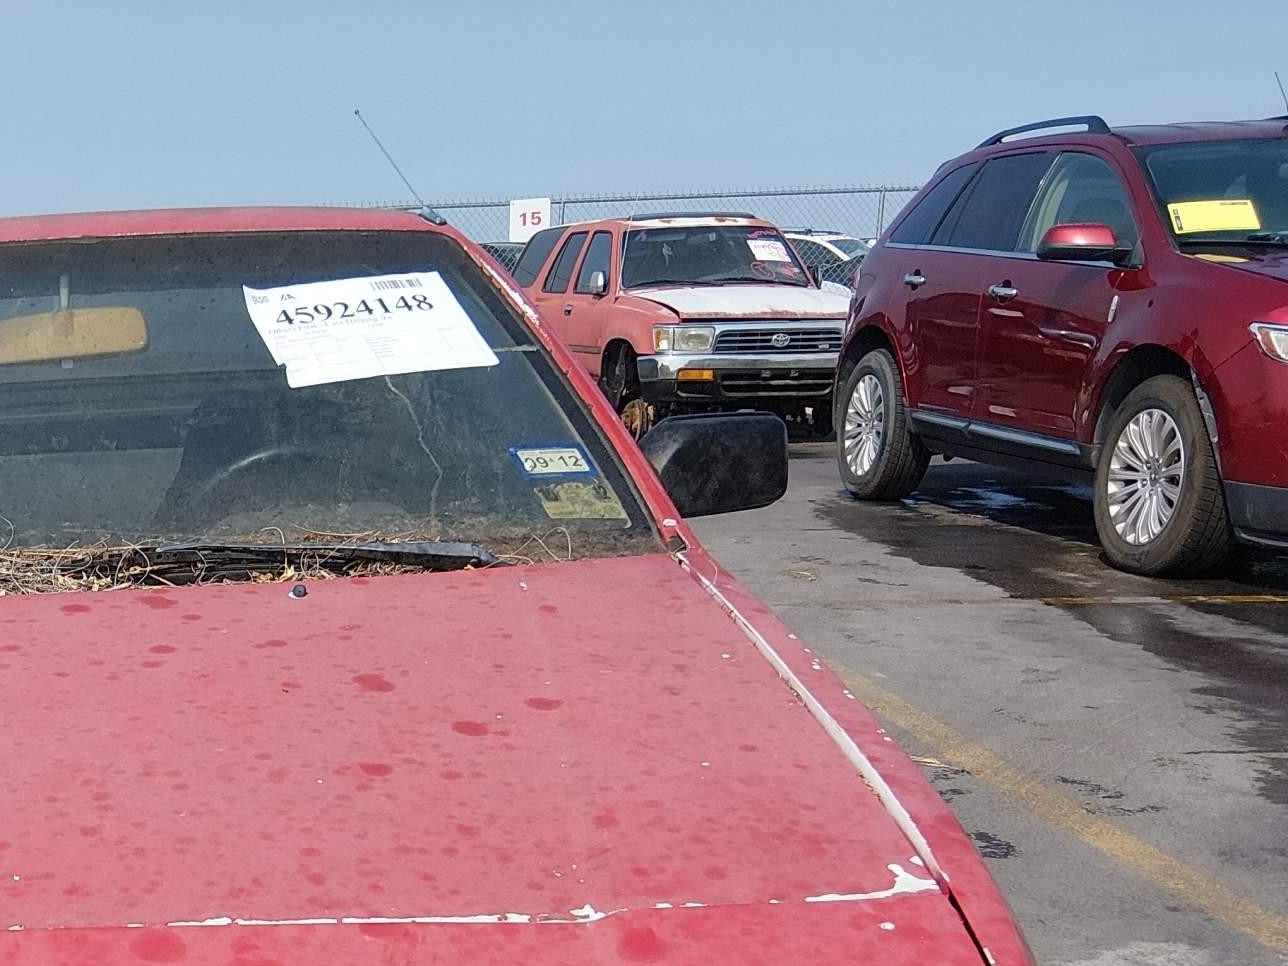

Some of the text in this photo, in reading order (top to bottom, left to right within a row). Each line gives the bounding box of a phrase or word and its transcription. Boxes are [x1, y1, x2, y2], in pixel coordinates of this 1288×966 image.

[519, 211, 543, 227] 15
[275, 293, 434, 326] 45924148
[557, 455, 583, 467] 12
